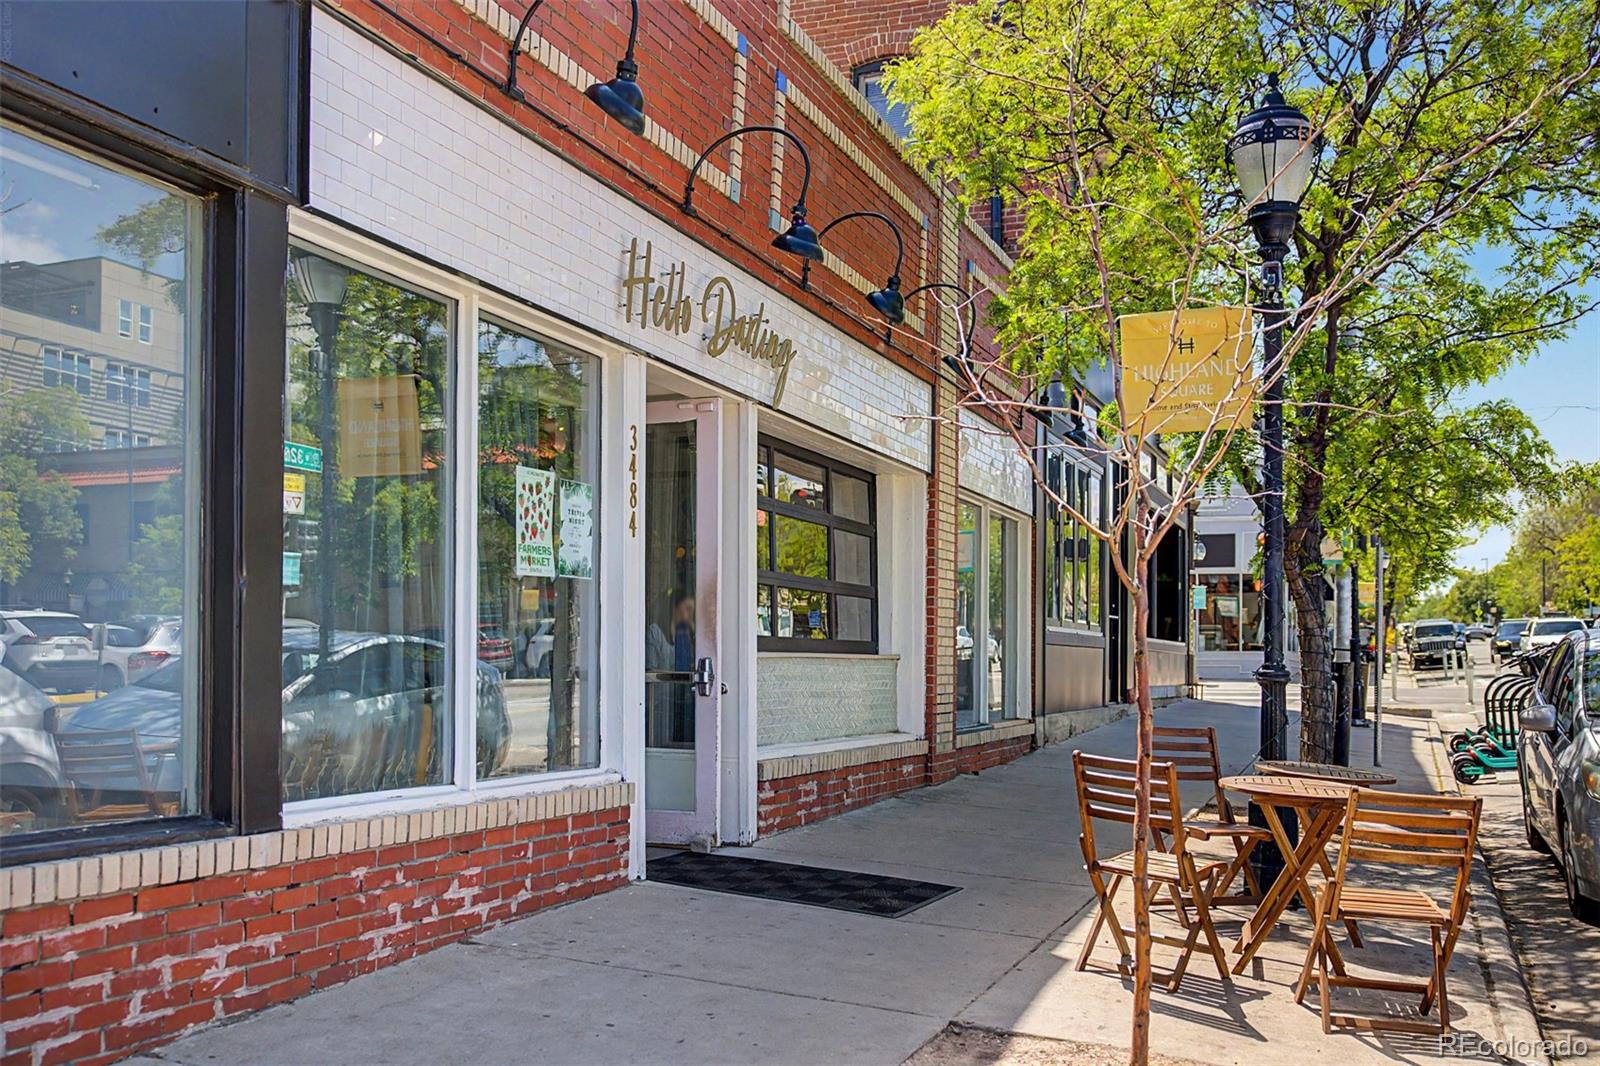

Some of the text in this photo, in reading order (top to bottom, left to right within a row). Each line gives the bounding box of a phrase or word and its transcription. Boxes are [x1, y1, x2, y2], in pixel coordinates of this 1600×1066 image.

[622, 237, 798, 410] Hello Darling
[1160, 383, 1214, 398] SQUARE
[628, 424, 638, 538] 3484
[518, 543, 552, 556] FARMERS
[520, 555, 551, 567] MRKET
